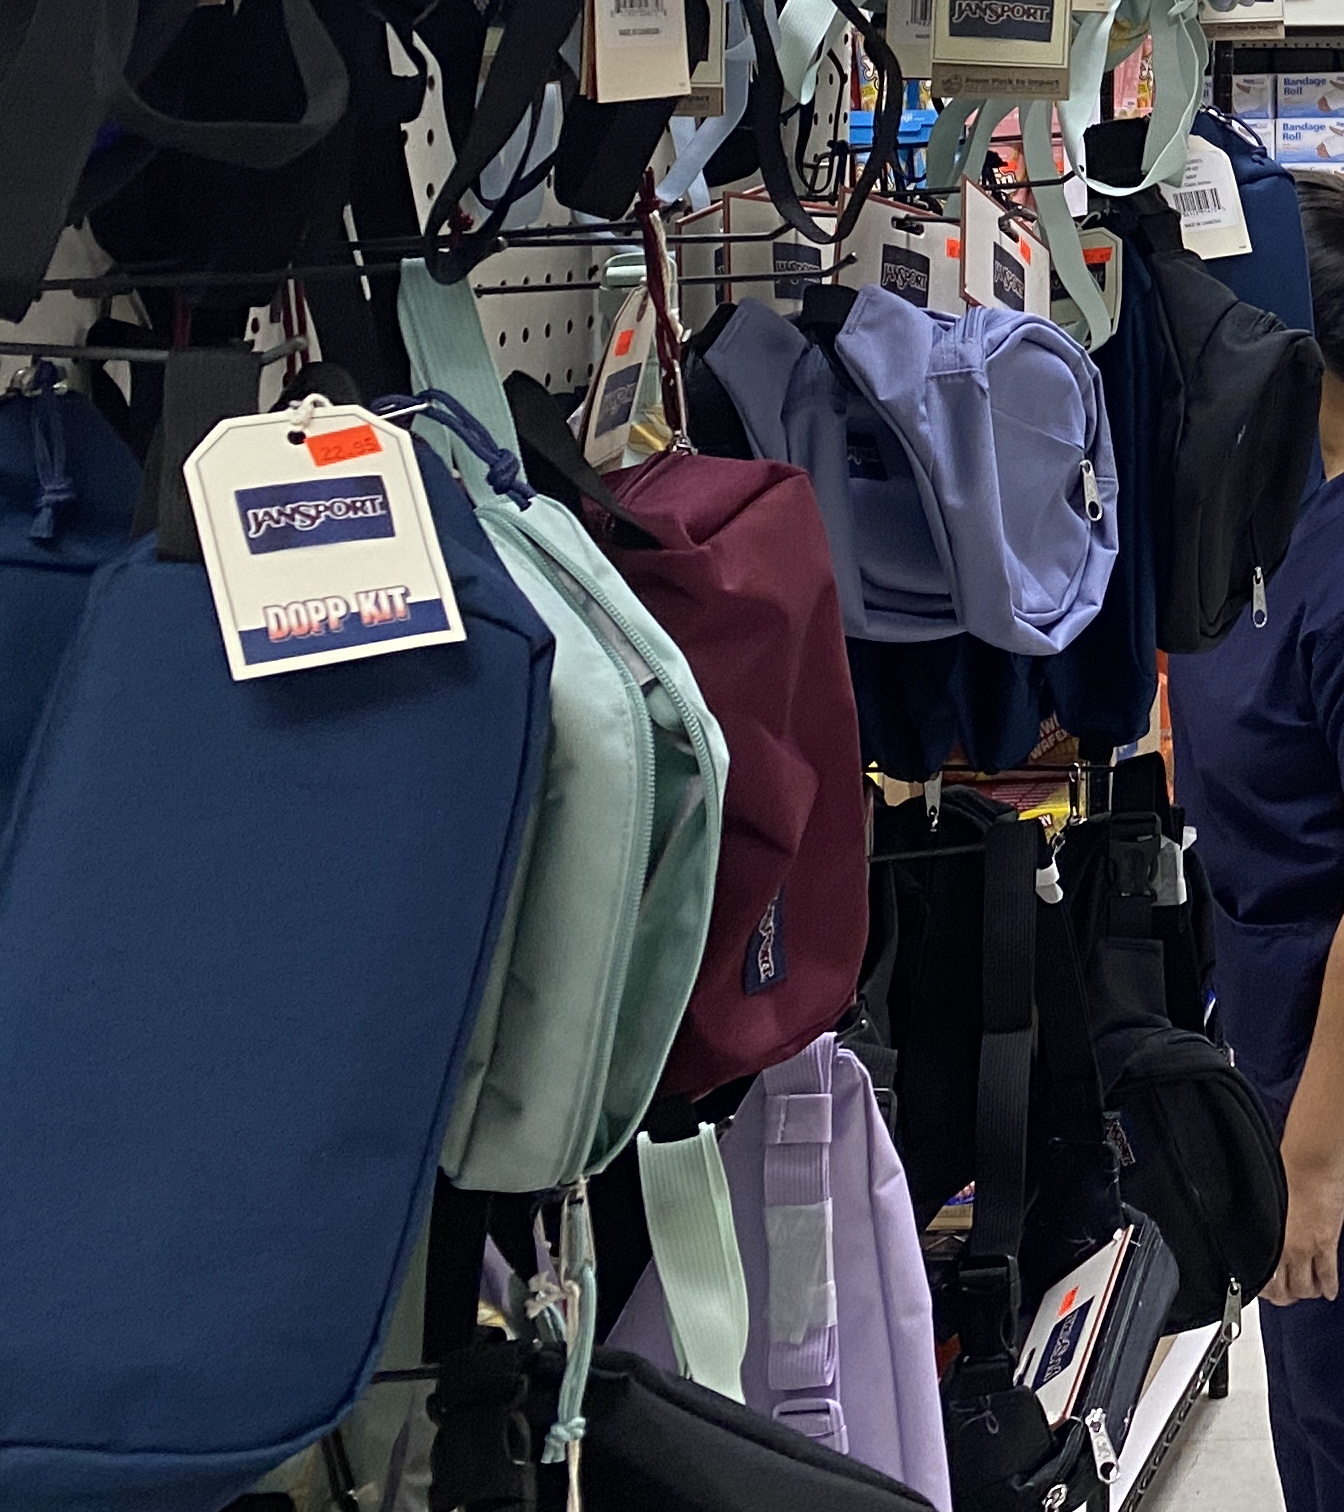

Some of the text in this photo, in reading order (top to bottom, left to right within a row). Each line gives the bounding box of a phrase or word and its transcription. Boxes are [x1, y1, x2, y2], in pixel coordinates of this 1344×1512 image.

[953, 0, 1051, 24] JANSPORT
[1283, 77, 1326, 88] Bandage
[1283, 86, 1303, 95] Roll
[1282, 122, 1326, 133] Bandage
[1282, 131, 1302, 141] Roll
[883, 263, 928, 293] JANSPORT
[248, 494, 387, 538] JANSPORT
[263, 585, 411, 642] DOPP KIT
